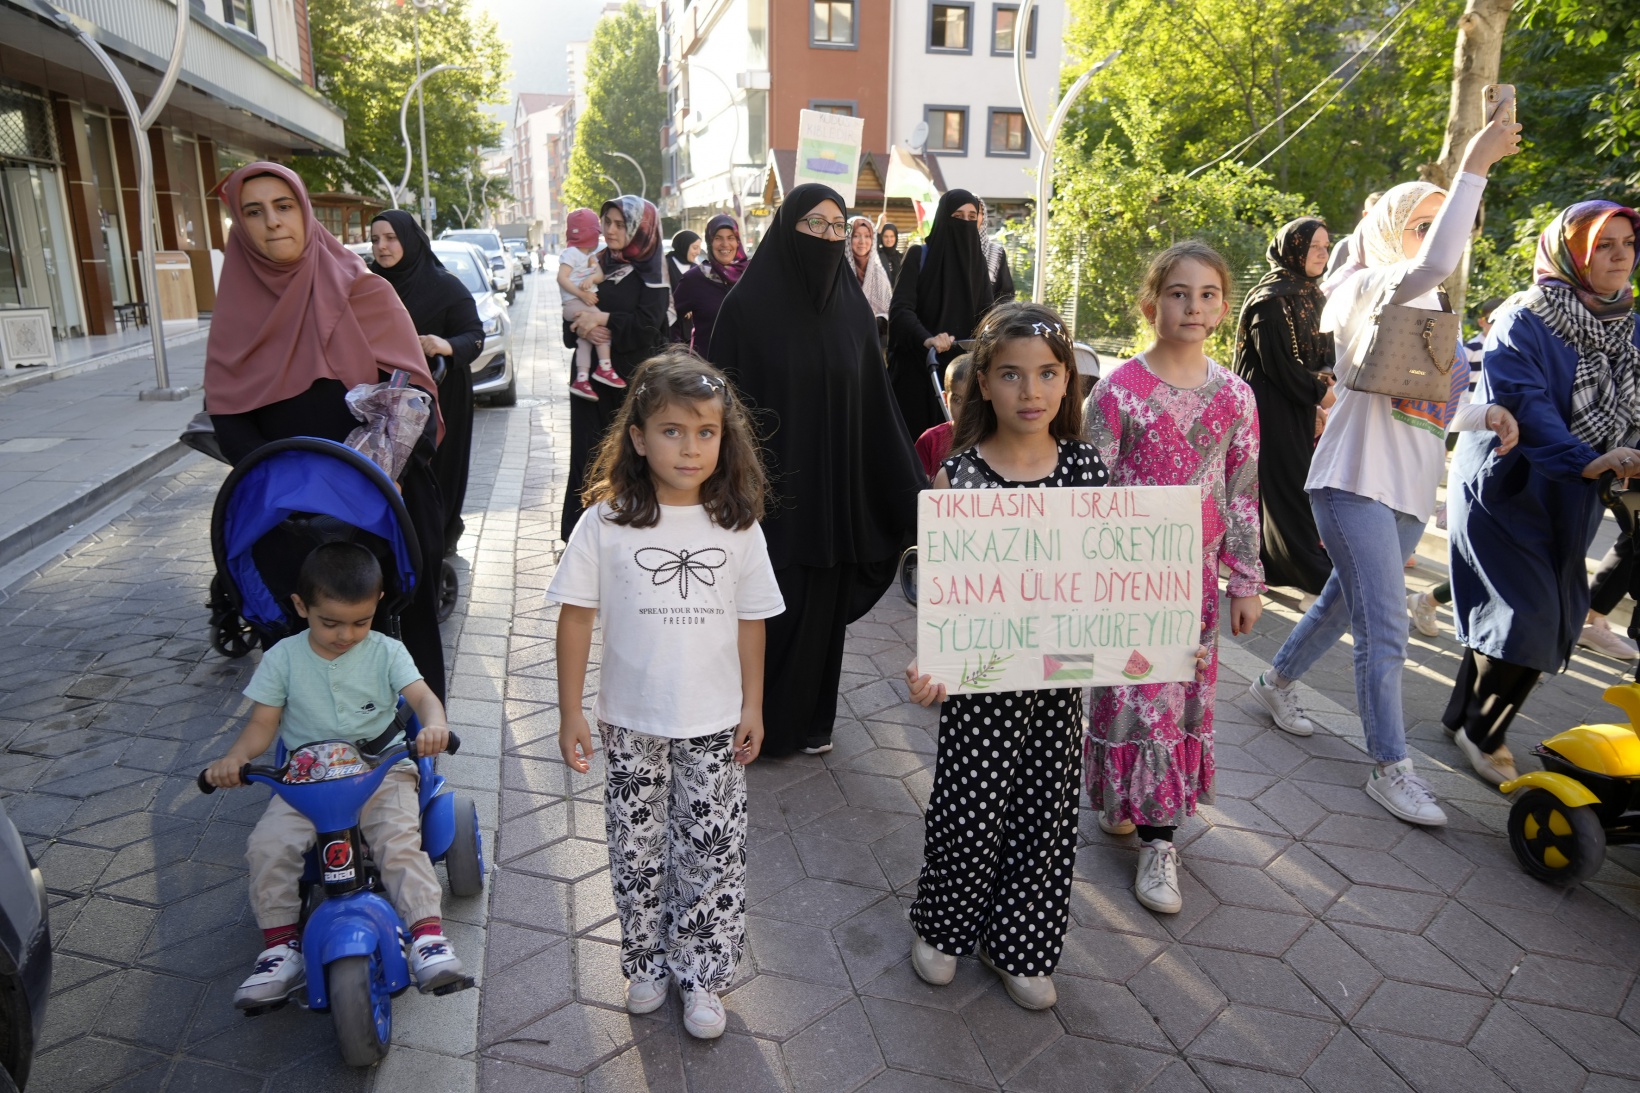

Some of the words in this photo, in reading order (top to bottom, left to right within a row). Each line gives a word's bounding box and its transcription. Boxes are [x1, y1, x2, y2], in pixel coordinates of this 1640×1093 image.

[928, 492, 1045, 518] YIKILASIN
[1071, 488, 1150, 518] İSRAİL
[927, 528, 1061, 562] ENKAZINI
[1082, 517, 1194, 564] GÖREYİM
[929, 573, 1006, 605] SANA
[1020, 568, 1083, 603] ÜLKE
[1094, 566, 1191, 603] DİYENİN
[639, 607, 668, 615] SPREAD
[693, 607, 714, 615] WINGS
[663, 616, 705, 625] FREEDOM
[927, 612, 1040, 652] YÜZÜNE
[1051, 606, 1194, 649] TÜKÜREYİM
[325, 763, 363, 778] SPEED
